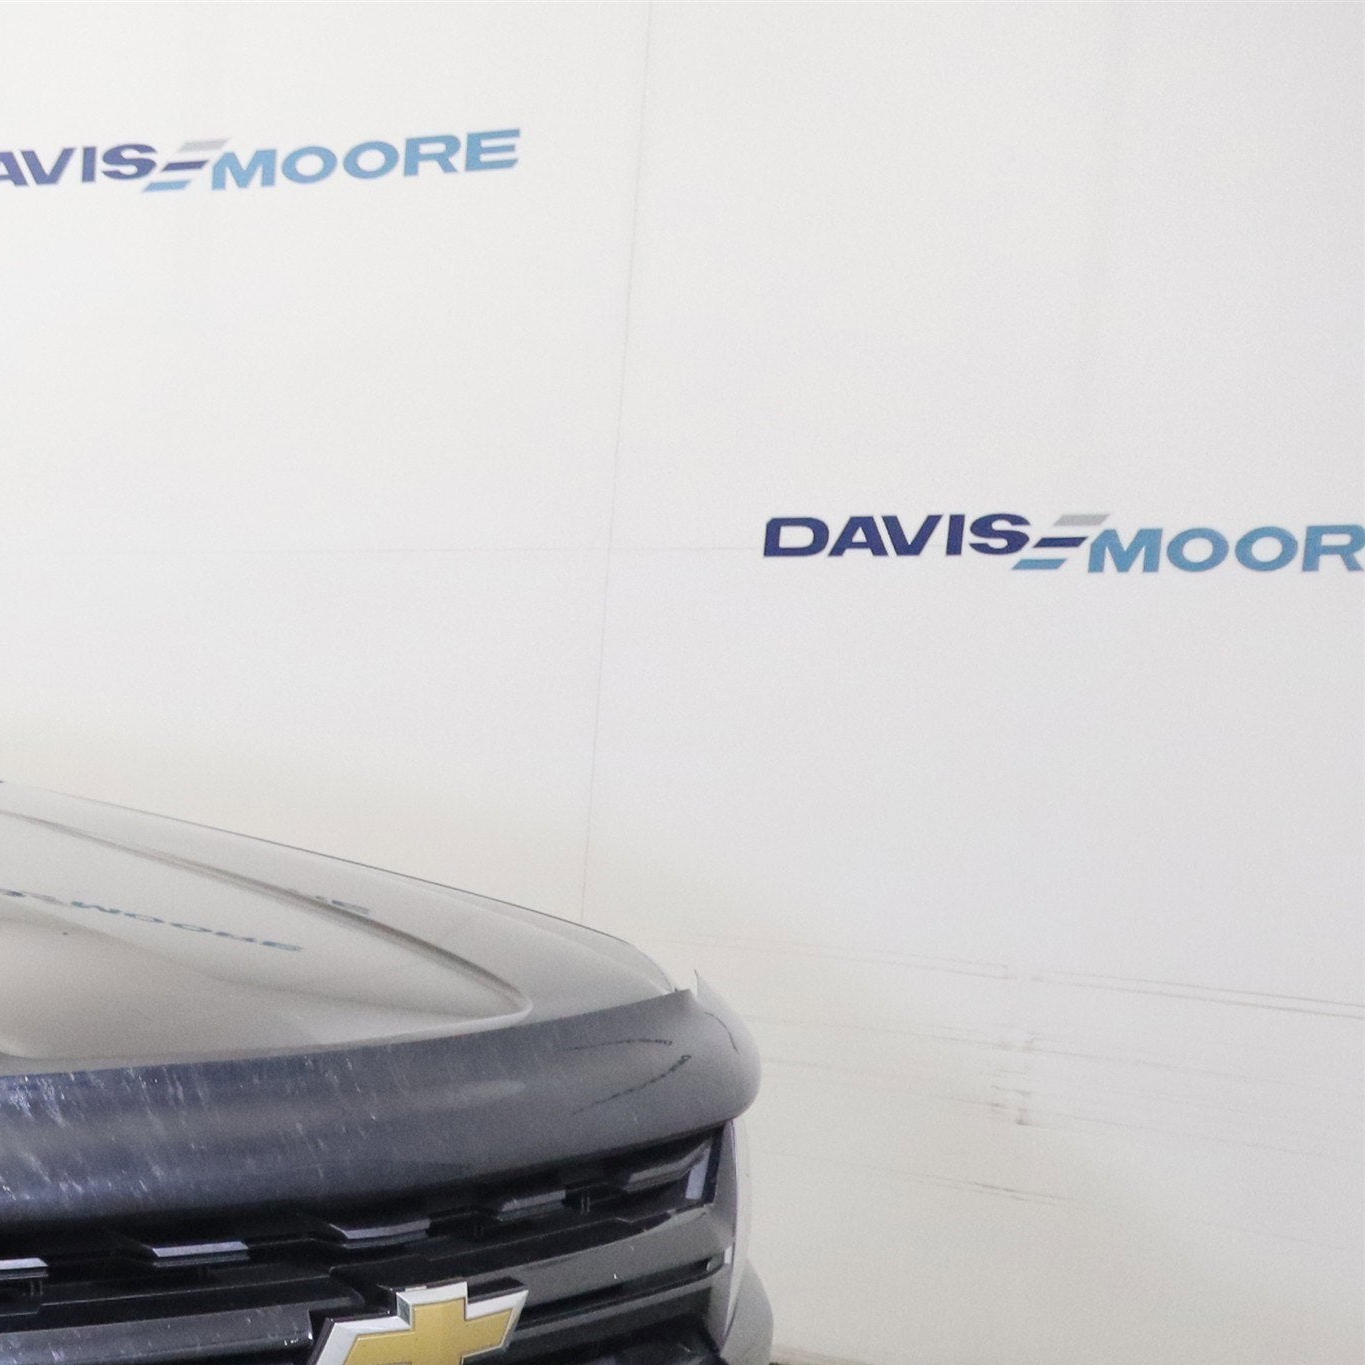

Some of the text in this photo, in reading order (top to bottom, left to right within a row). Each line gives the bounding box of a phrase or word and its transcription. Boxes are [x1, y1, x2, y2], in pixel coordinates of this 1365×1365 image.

[211, 128, 521, 191] MOORE
[762, 511, 1365, 573] DAVIS MOOR
